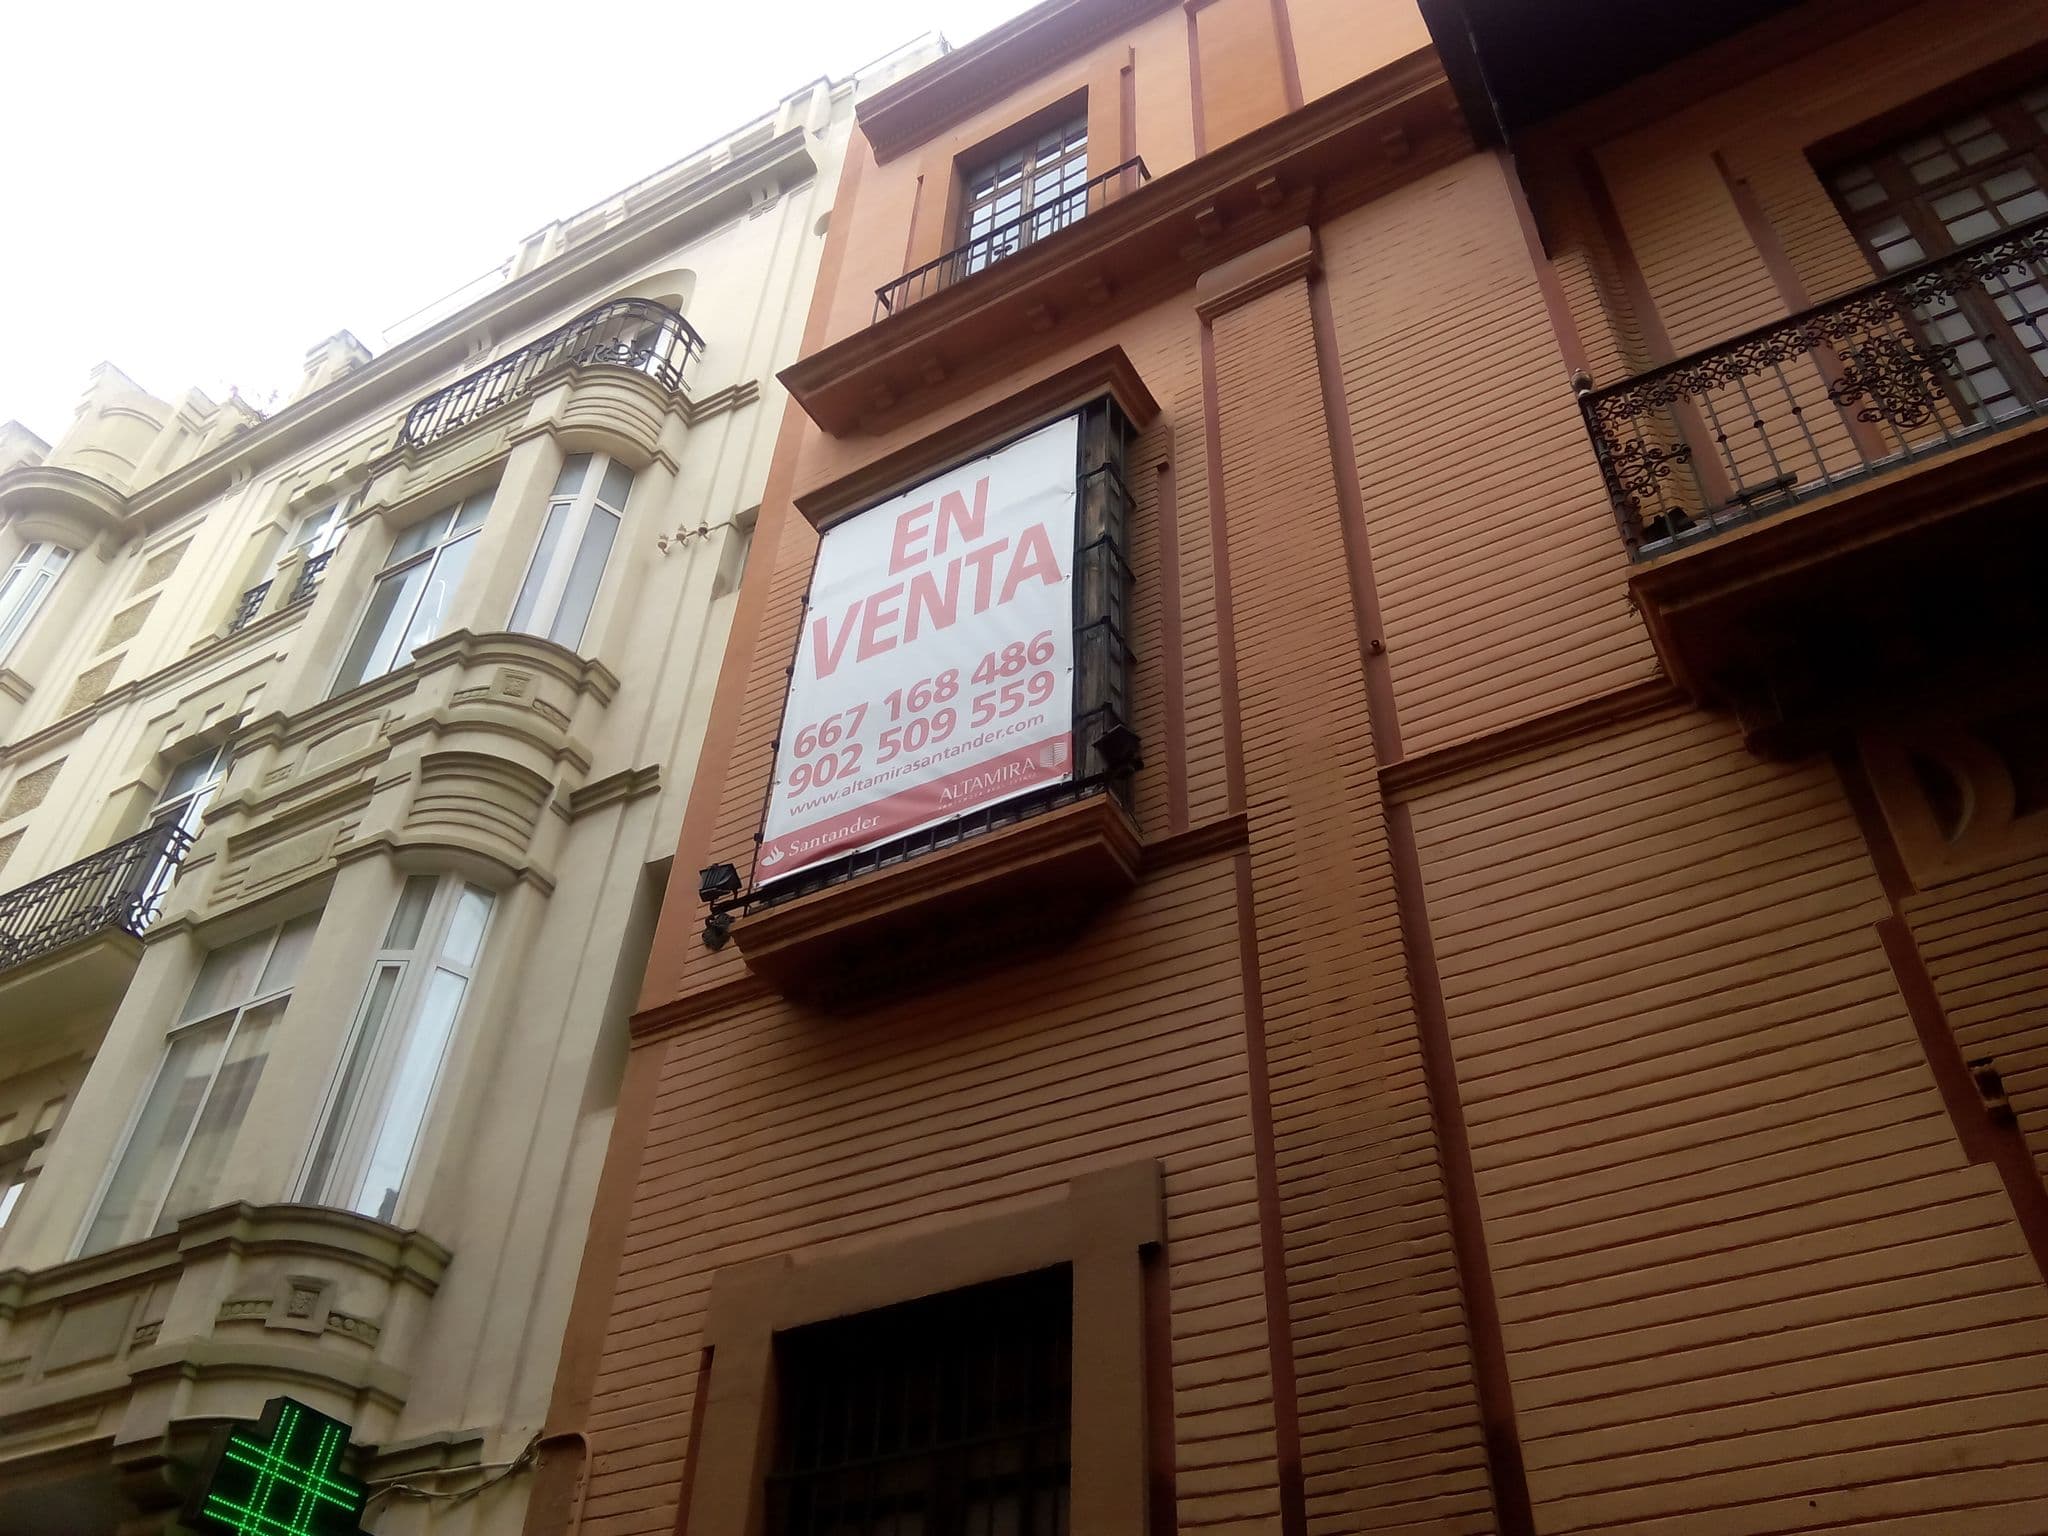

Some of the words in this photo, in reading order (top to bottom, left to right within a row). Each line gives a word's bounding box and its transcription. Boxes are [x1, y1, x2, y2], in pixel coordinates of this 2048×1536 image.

[888, 475, 990, 577] EN
[812, 521, 1063, 681] VENTA
[786, 743, 863, 799] 902
[876, 707, 957, 765] 509
[970, 670, 1055, 729] 559
[793, 701, 869, 759] 667
[883, 668, 960, 722] 168
[970, 629, 1055, 686] 486
[789, 713, 1044, 817] www.altamirasantander.com
[939, 757, 1036, 803] ALTAMIRA
[788, 813, 880, 857] Santander
